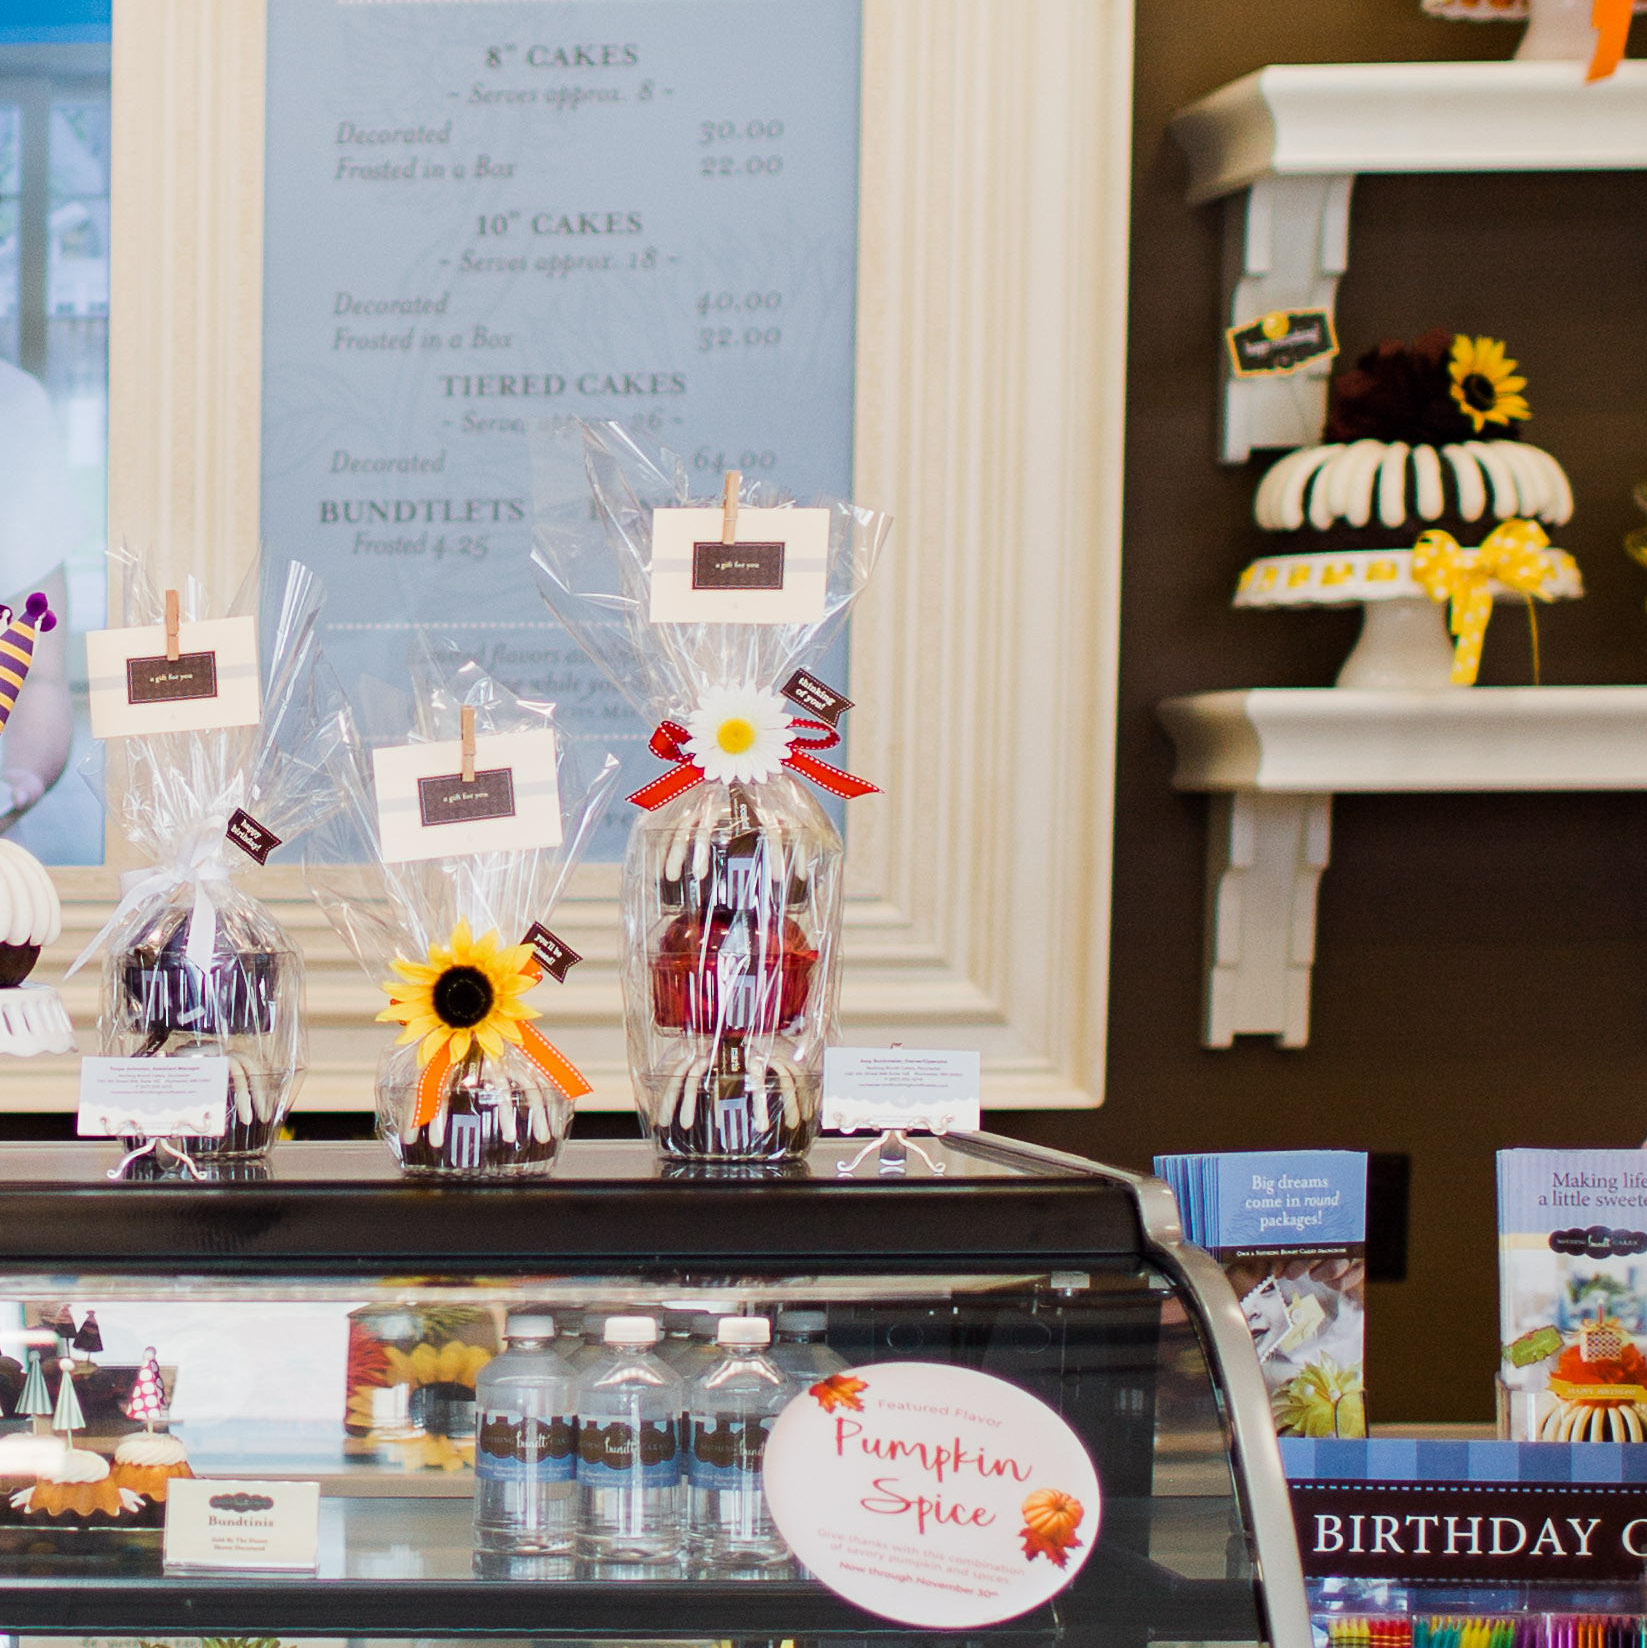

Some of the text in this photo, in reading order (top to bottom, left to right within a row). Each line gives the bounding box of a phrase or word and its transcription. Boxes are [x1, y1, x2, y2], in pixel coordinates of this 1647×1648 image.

[526, 44, 639, 68] CAKES
[638, 81, 654, 102] 8
[336, 121, 451, 144] Decorated
[699, 121, 784, 142] 30.00
[334, 156, 515, 179] Frosted in a Box
[701, 156, 782, 176] 22.00
[531, 212, 642, 235] CAKES
[333, 293, 448, 315] Decorated
[696, 291, 781, 315] 40.00
[332, 327, 511, 351] Frosted in a Box
[699, 327, 780, 349] 32.00
[439, 373, 687, 397] TIERED CAKES
[331, 450, 445, 474] Decorated
[693, 448, 776, 475] 64.00
[320, 499, 524, 524] BUNDTLETS
[354, 532, 489, 558] Frosted 4.25
[796, 689, 826, 710] of you!
[798, 677, 836, 706] thinking
[1252, 1174, 1328, 1194] Big dreams
[1552, 1172, 1647, 1193] Making life
[1246, 1190, 1340, 1208] come in round
[1538, 1190, 1590, 1206] a little
[1260, 1210, 1322, 1231] packages!
[878, 1400, 1003, 1428] Featured Flavor
[835, 1417, 1032, 1482] Pumpkin
[861, 1478, 996, 1535] Spice
[208, 1515, 274, 1527] Bundtinis
[1314, 1514, 1601, 1557] BIRTHDAY
[840, 1561, 974, 1595] Now through November
